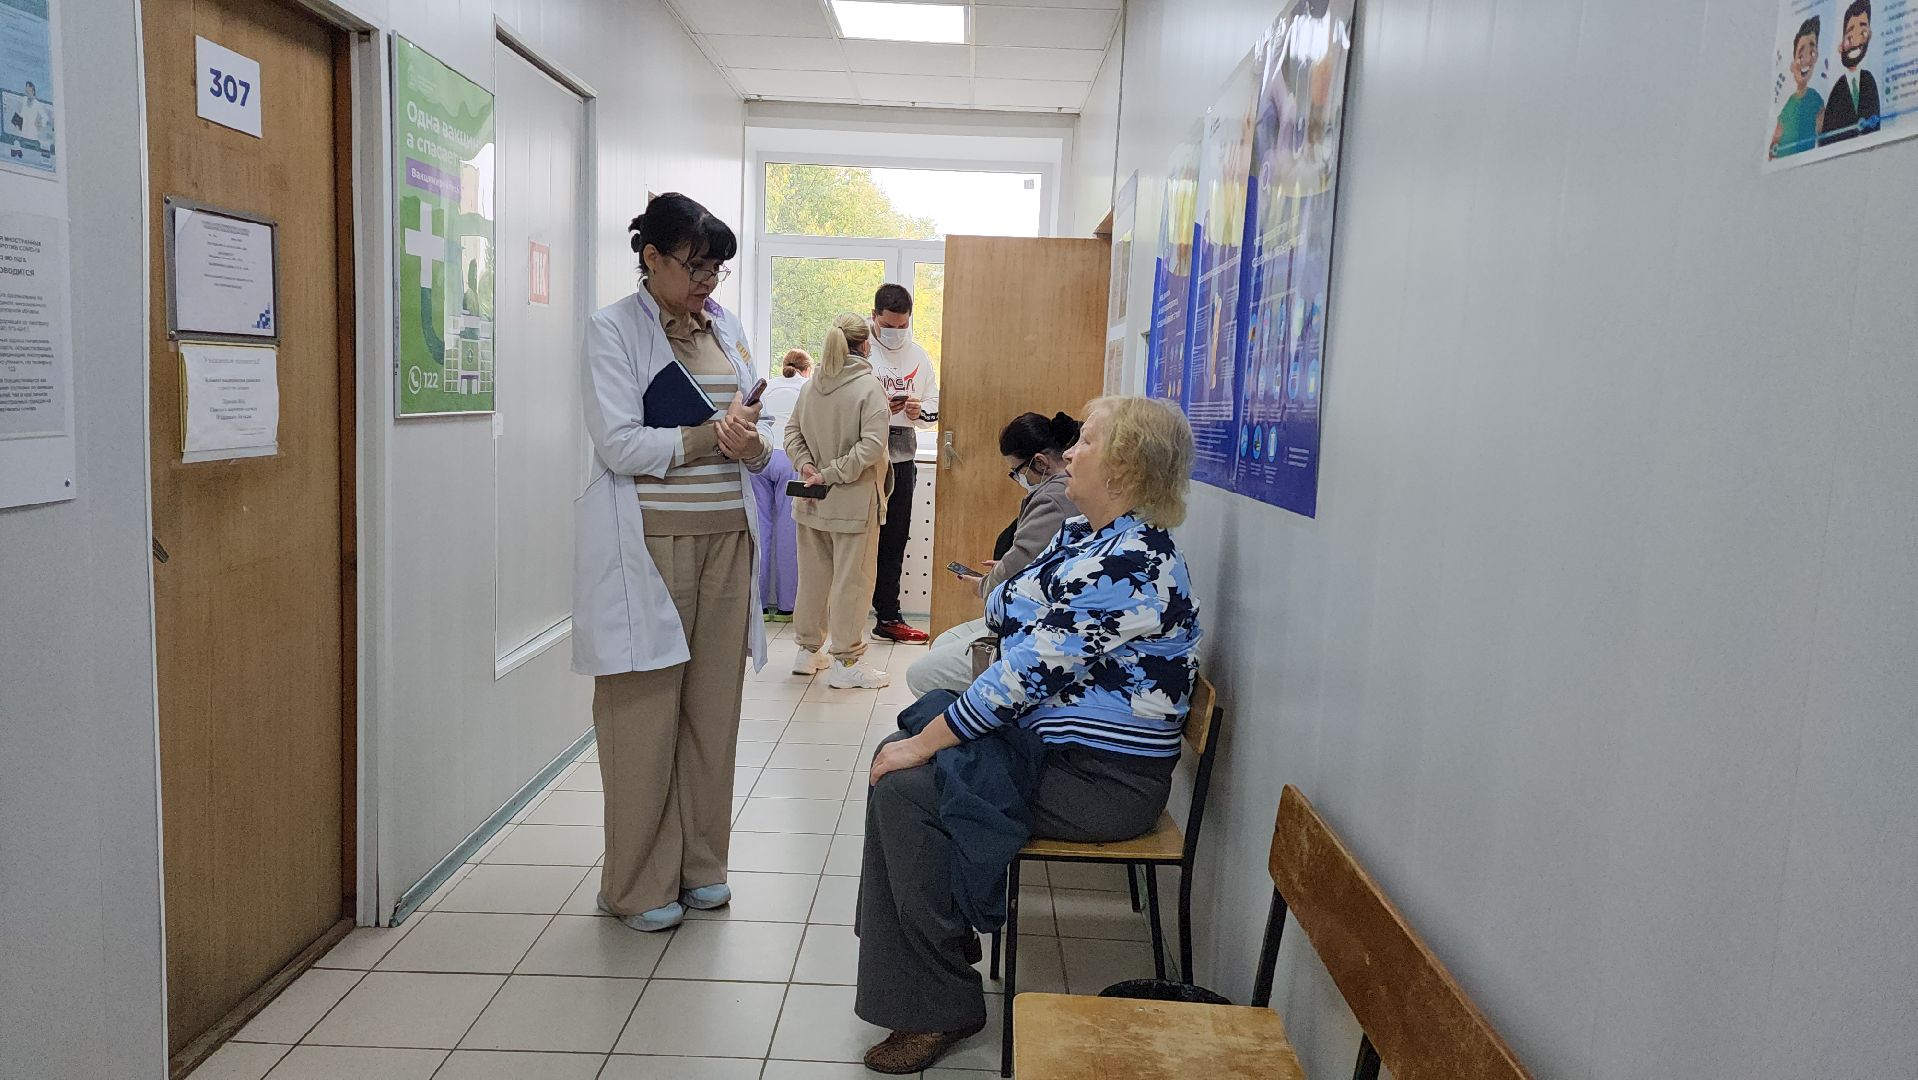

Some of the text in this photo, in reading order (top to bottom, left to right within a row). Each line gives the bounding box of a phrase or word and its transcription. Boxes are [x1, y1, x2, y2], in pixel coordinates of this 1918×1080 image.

[209, 67, 250, 107] 307
[406, 100, 440, 135] Одна
[406, 132, 414, 149] а
[422, 371, 439, 389] 122
